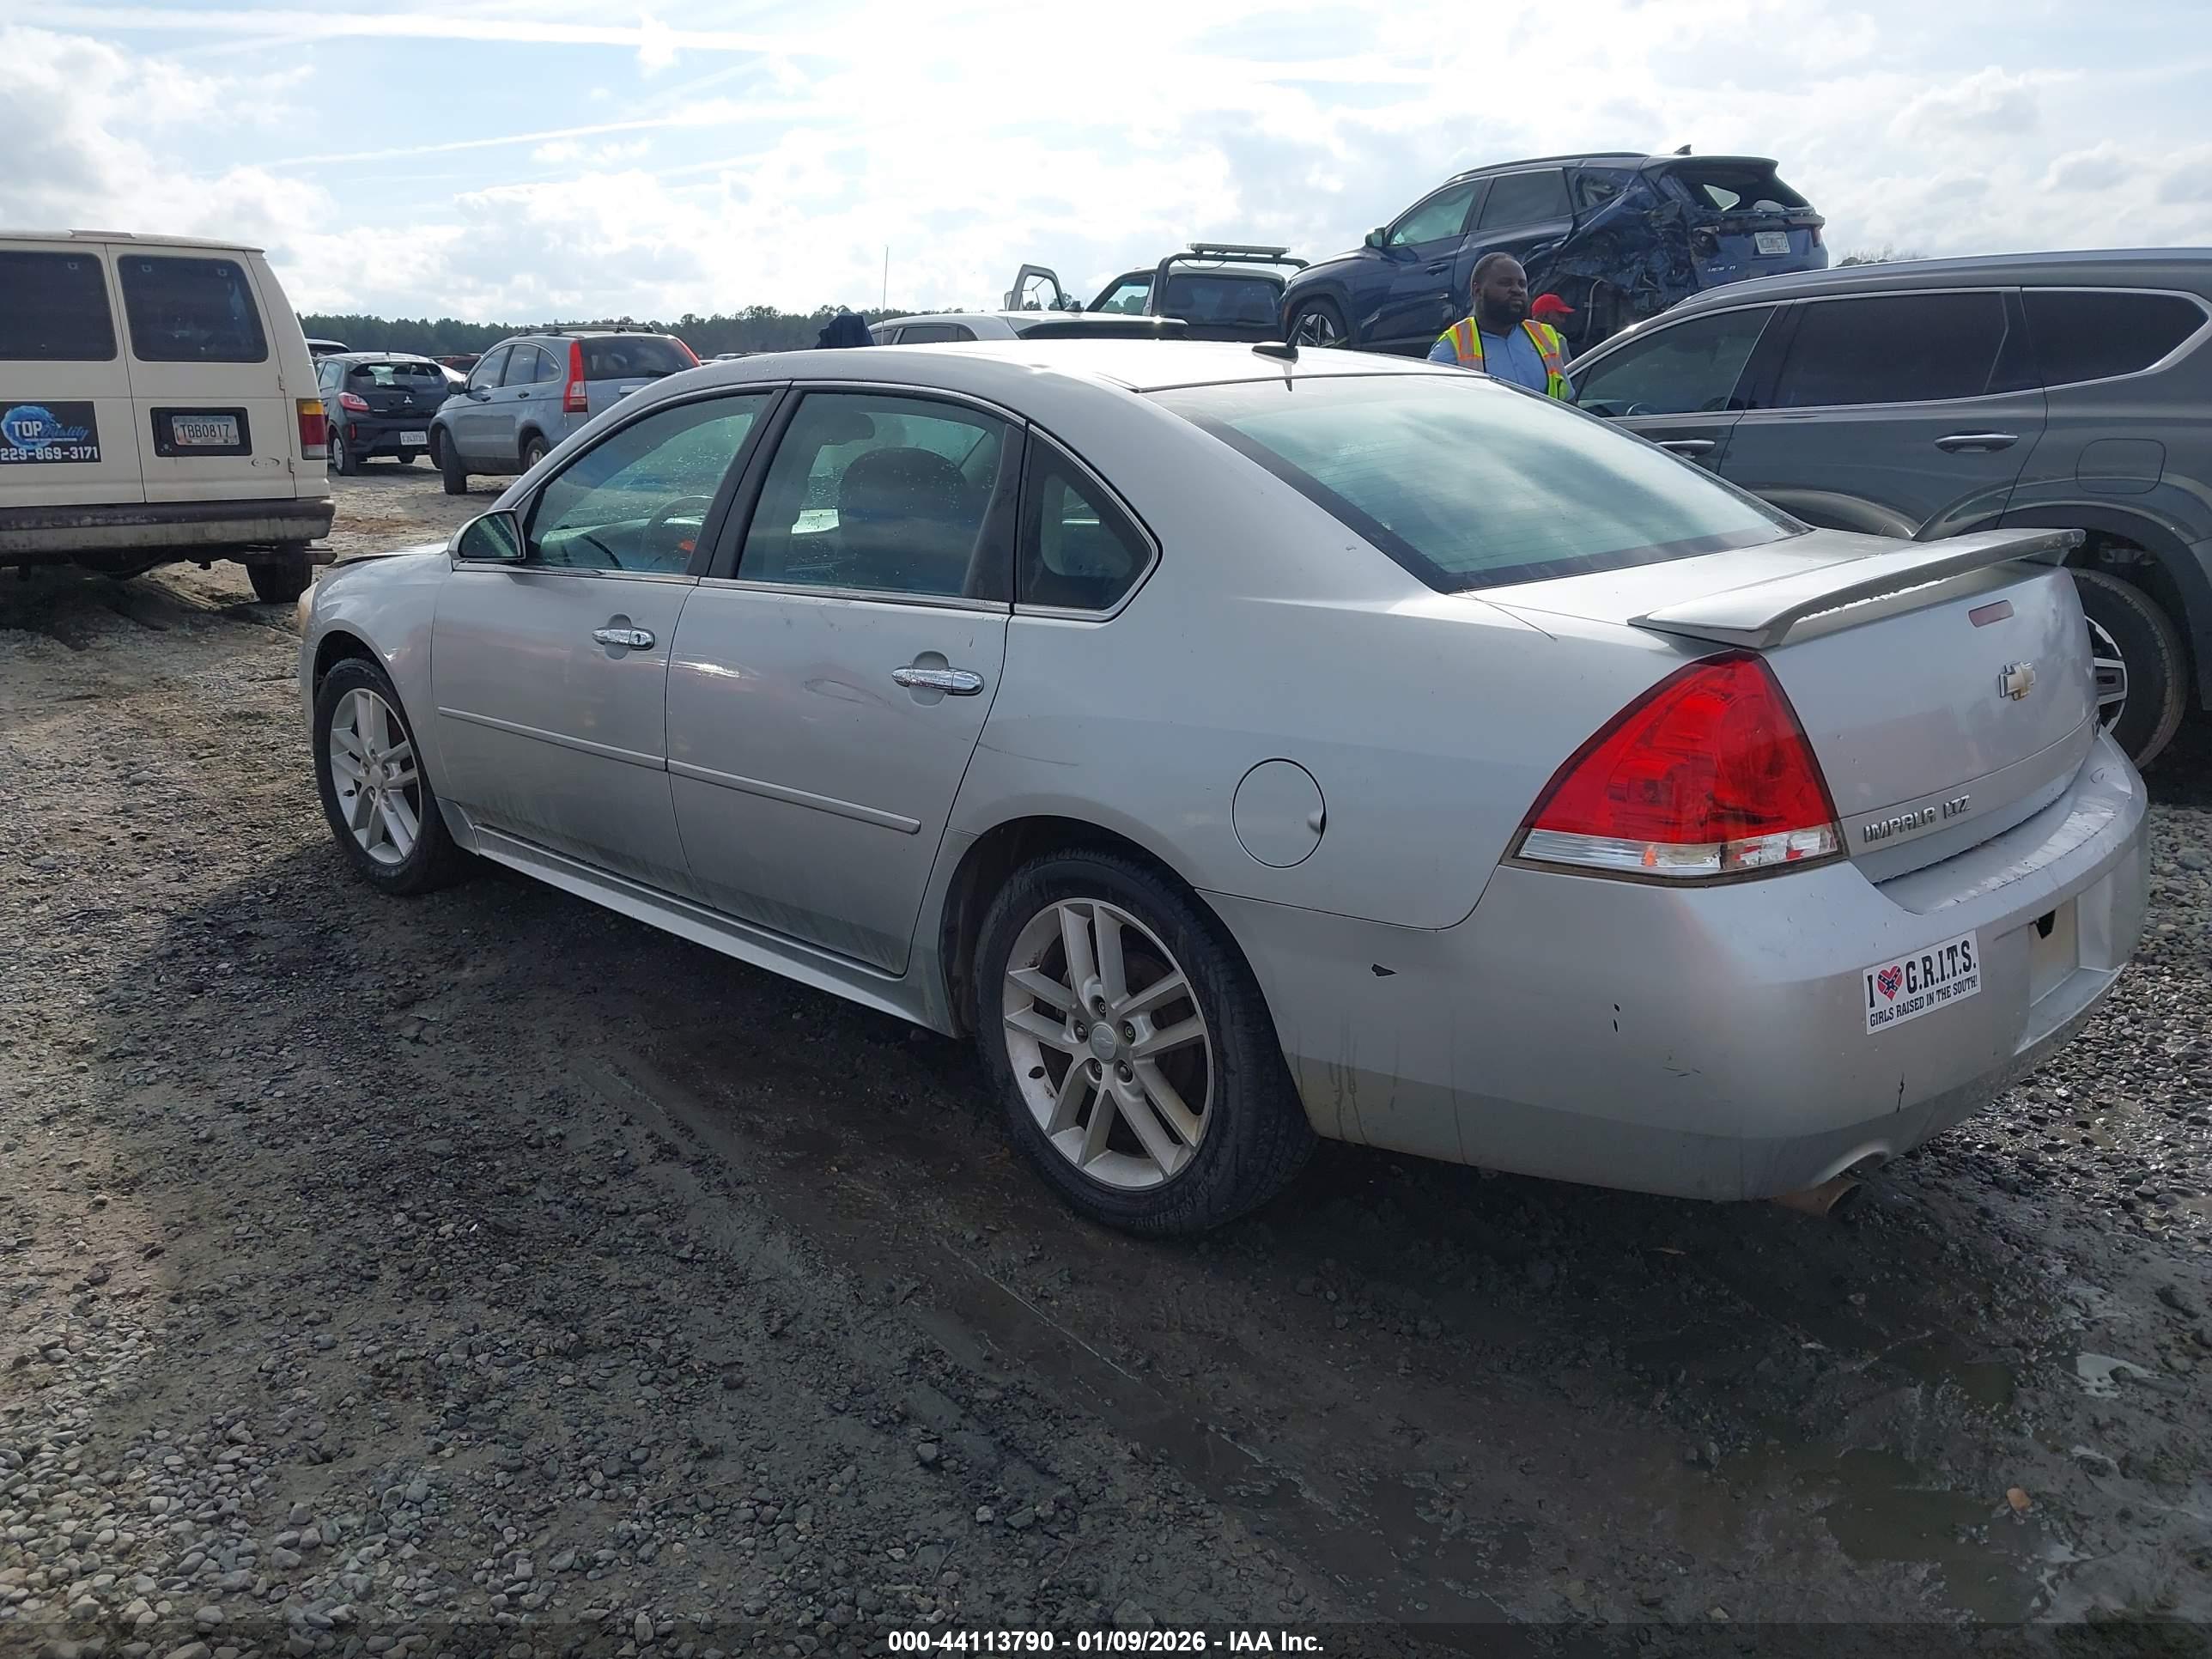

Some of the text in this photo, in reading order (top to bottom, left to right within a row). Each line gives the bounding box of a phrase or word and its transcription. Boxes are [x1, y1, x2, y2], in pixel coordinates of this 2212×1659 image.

[11, 421, 43, 436] TOP
[179, 424, 229, 438] TBB0817
[0, 447, 98, 460] 229-869-3171
[1863, 794, 1971, 842] IMPALA LTZ
[1868, 940, 1977, 1008] I G.R.I.T.S.
[1869, 975, 1978, 1027] GIRLS RAISED IN THE SOUTH!
